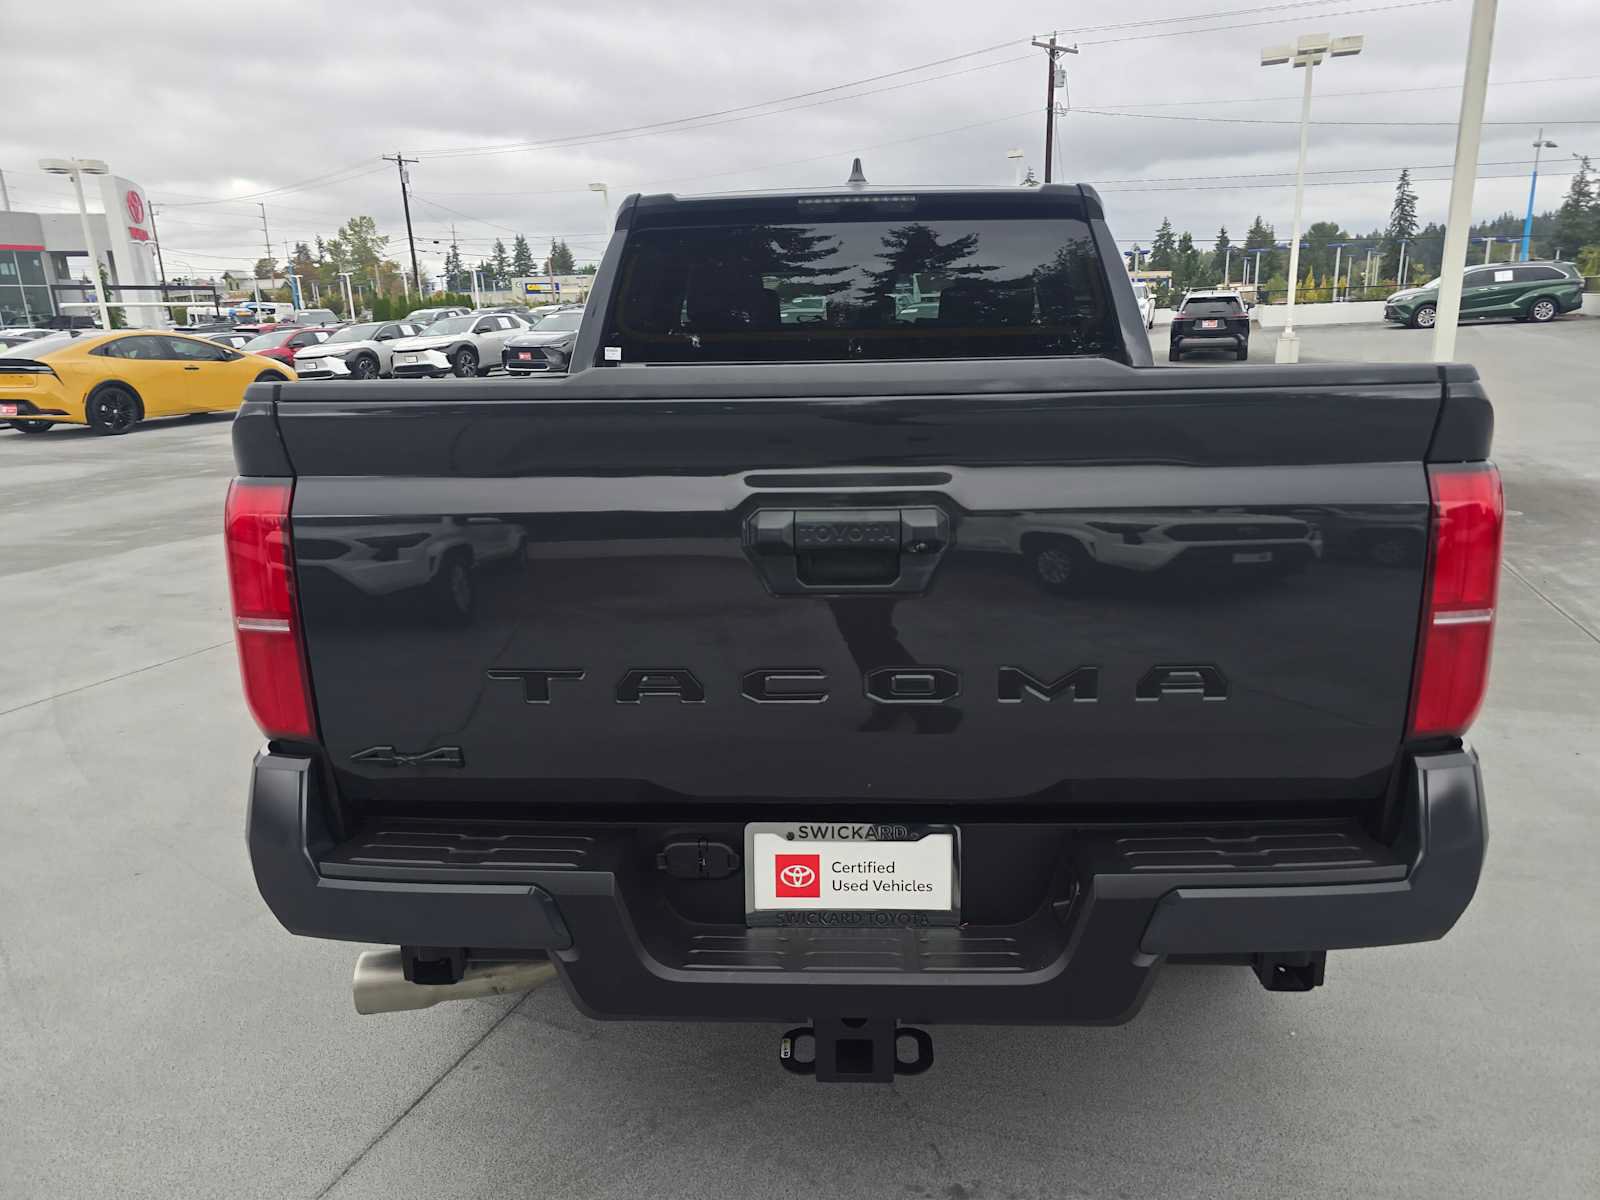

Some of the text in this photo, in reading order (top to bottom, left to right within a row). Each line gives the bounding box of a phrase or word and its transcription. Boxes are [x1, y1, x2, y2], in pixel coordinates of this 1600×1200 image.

[798, 524, 897, 543] TOYOTA
[486, 665, 1228, 705] TACOMA
[798, 825, 908, 840] SWICKARD
[831, 861, 895, 874] Certified
[832, 879, 933, 892] Used Vehicles
[776, 911, 930, 926] SWICKARD TOYOTA
